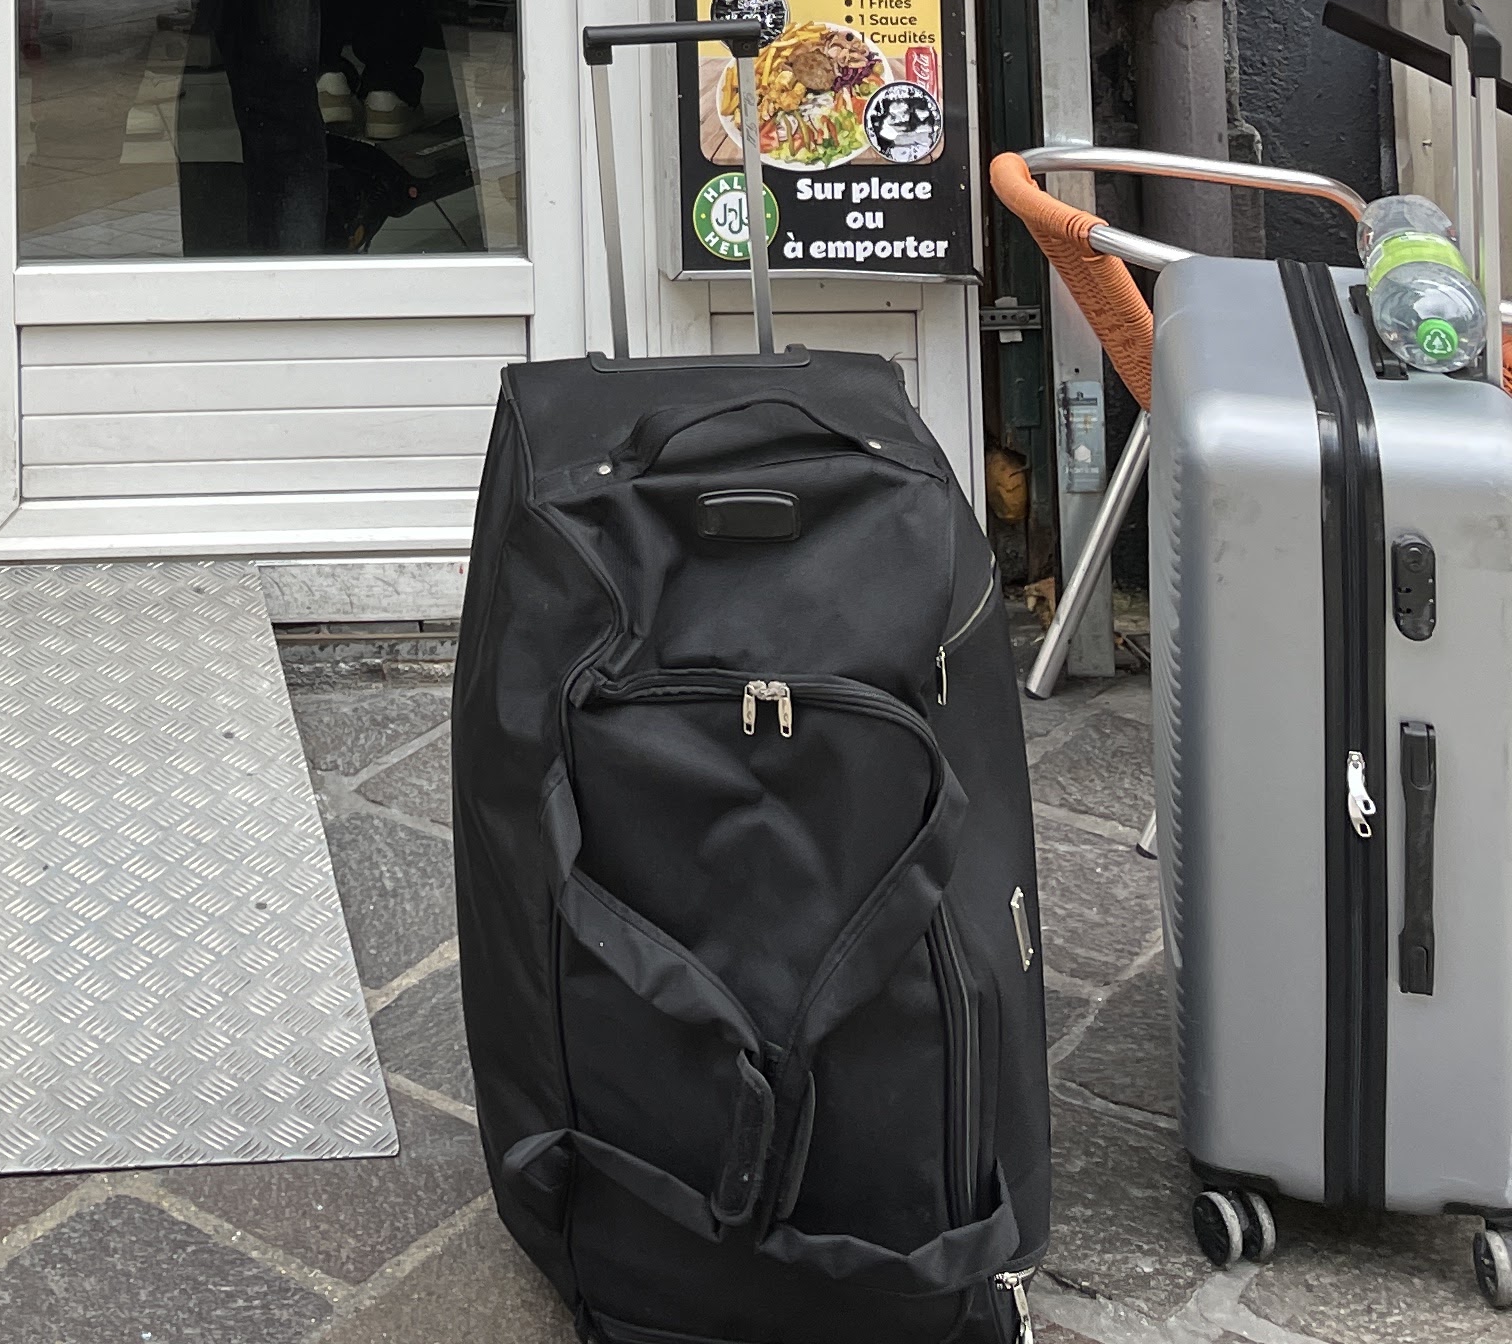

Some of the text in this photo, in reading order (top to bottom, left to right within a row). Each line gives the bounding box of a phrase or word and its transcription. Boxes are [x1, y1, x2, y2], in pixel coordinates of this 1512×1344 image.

[860, 31, 936, 44] 1 Crudités
[796, 178, 932, 202] Sur place
[846, 212, 885, 229] ou
[783, 233, 948, 262] à emporter
